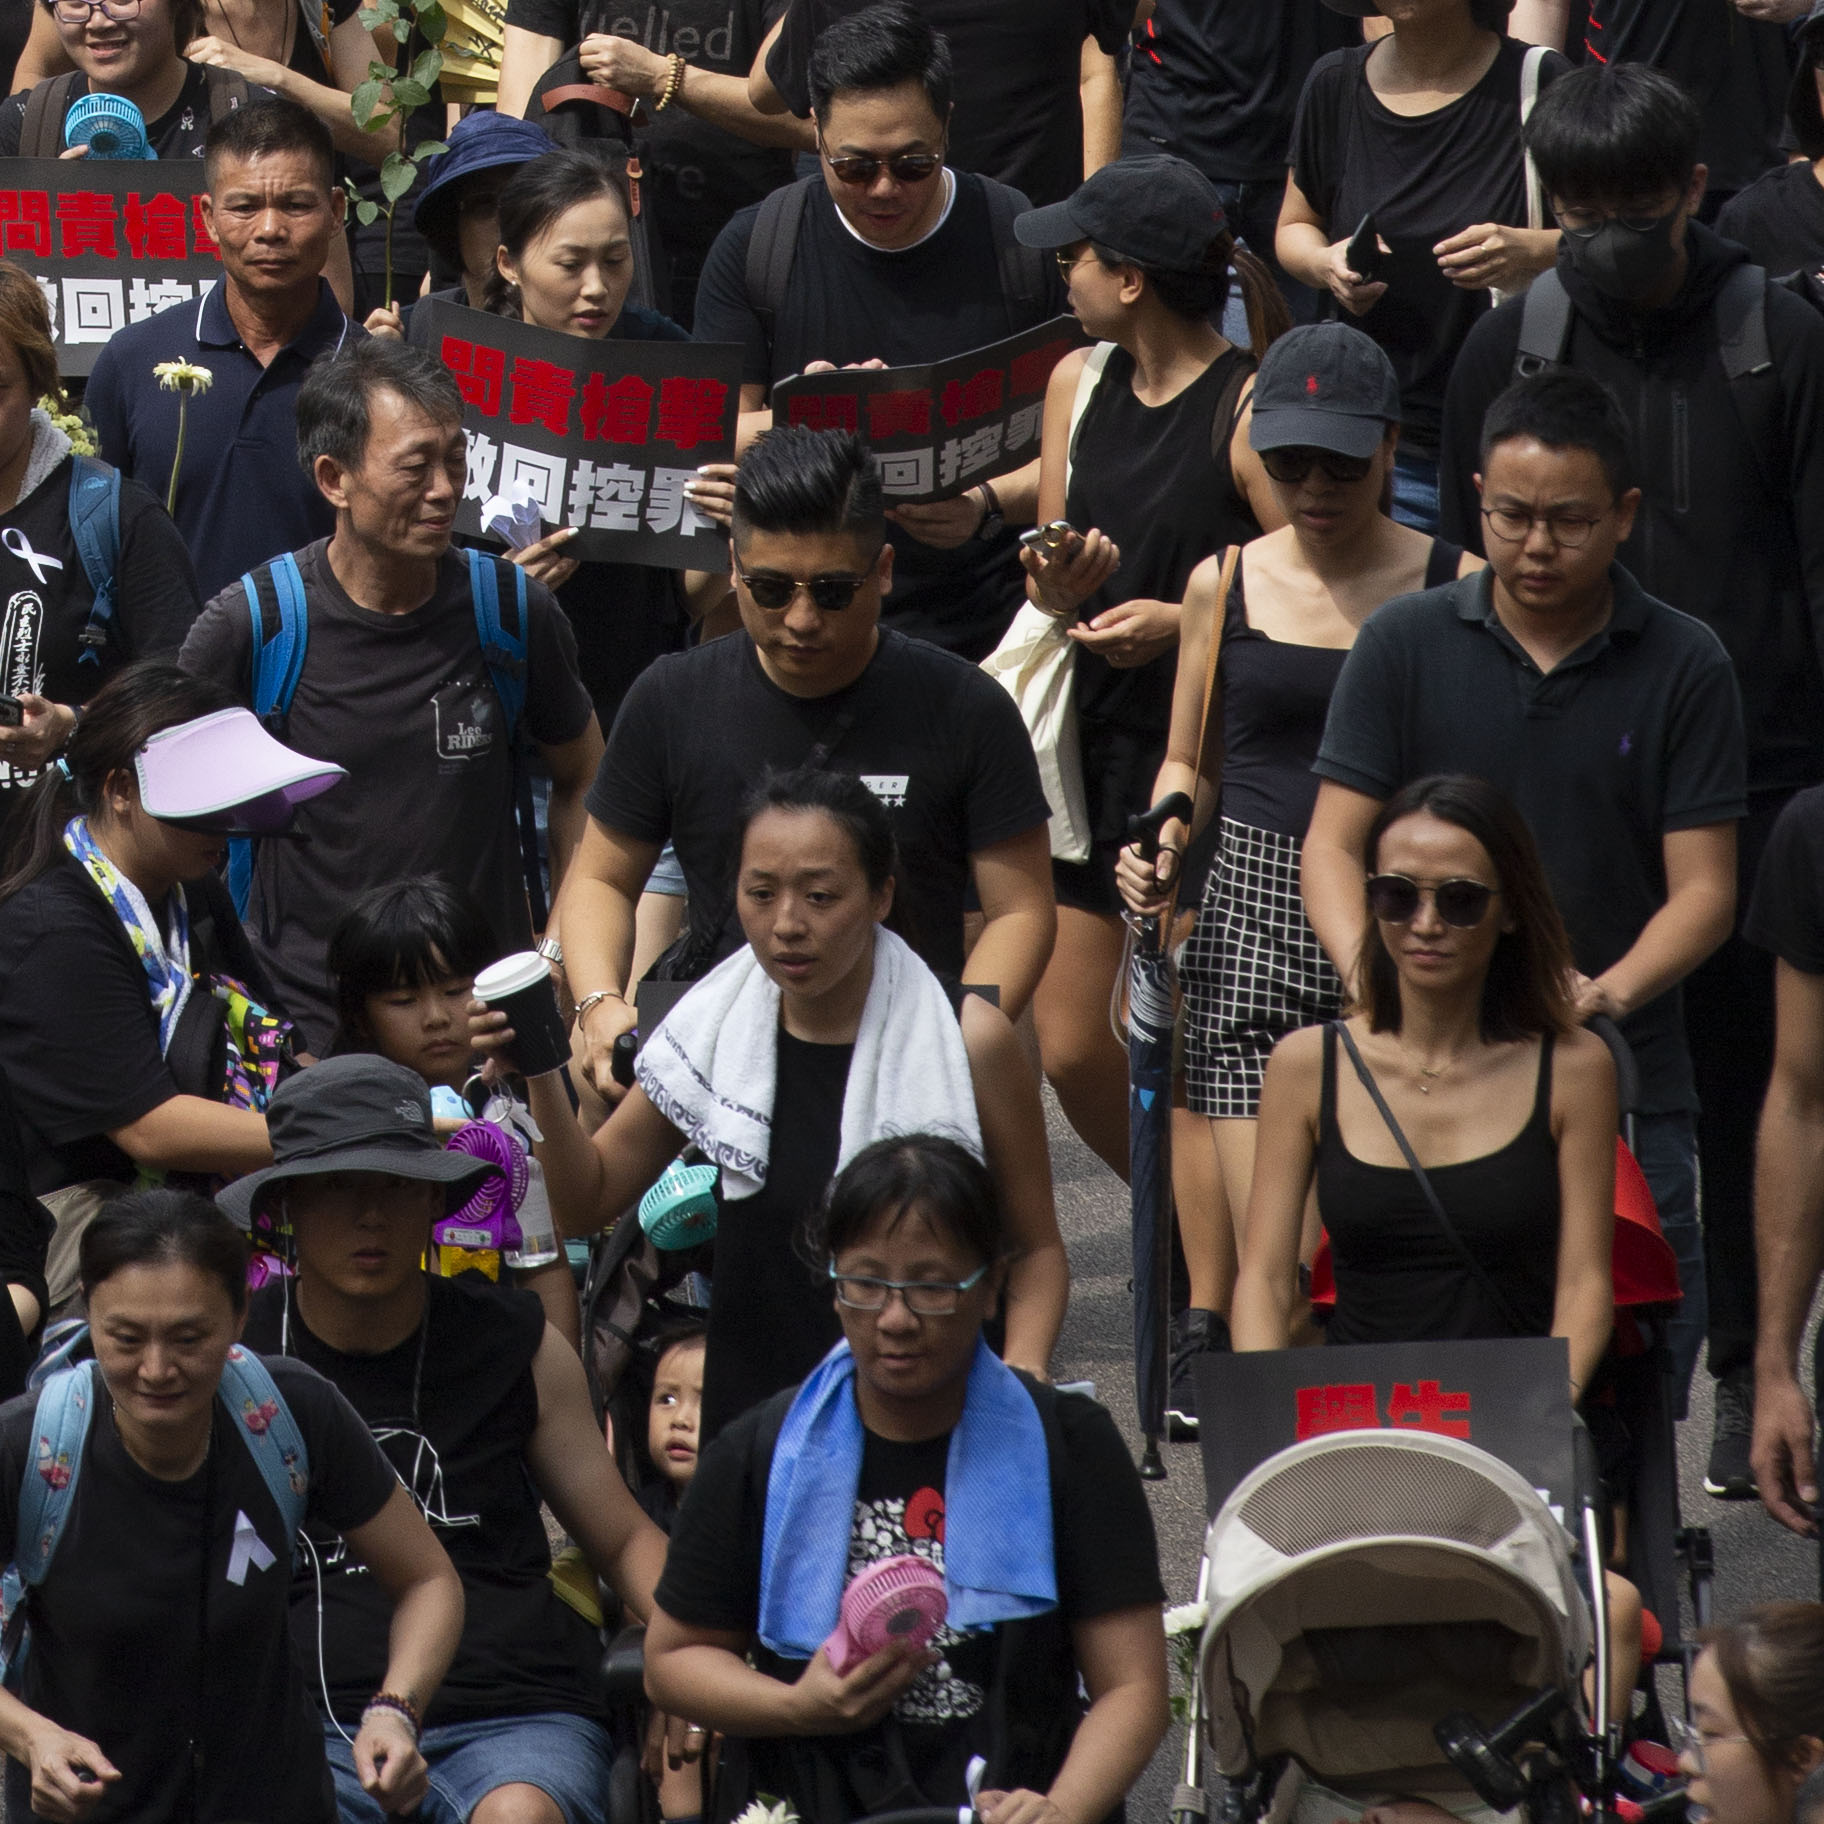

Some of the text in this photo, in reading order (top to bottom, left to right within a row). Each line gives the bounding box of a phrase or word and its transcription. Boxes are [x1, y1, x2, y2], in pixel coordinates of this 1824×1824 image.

[441, 338, 729, 450] 問責槍擊
[456, 722, 483, 736] Lee
